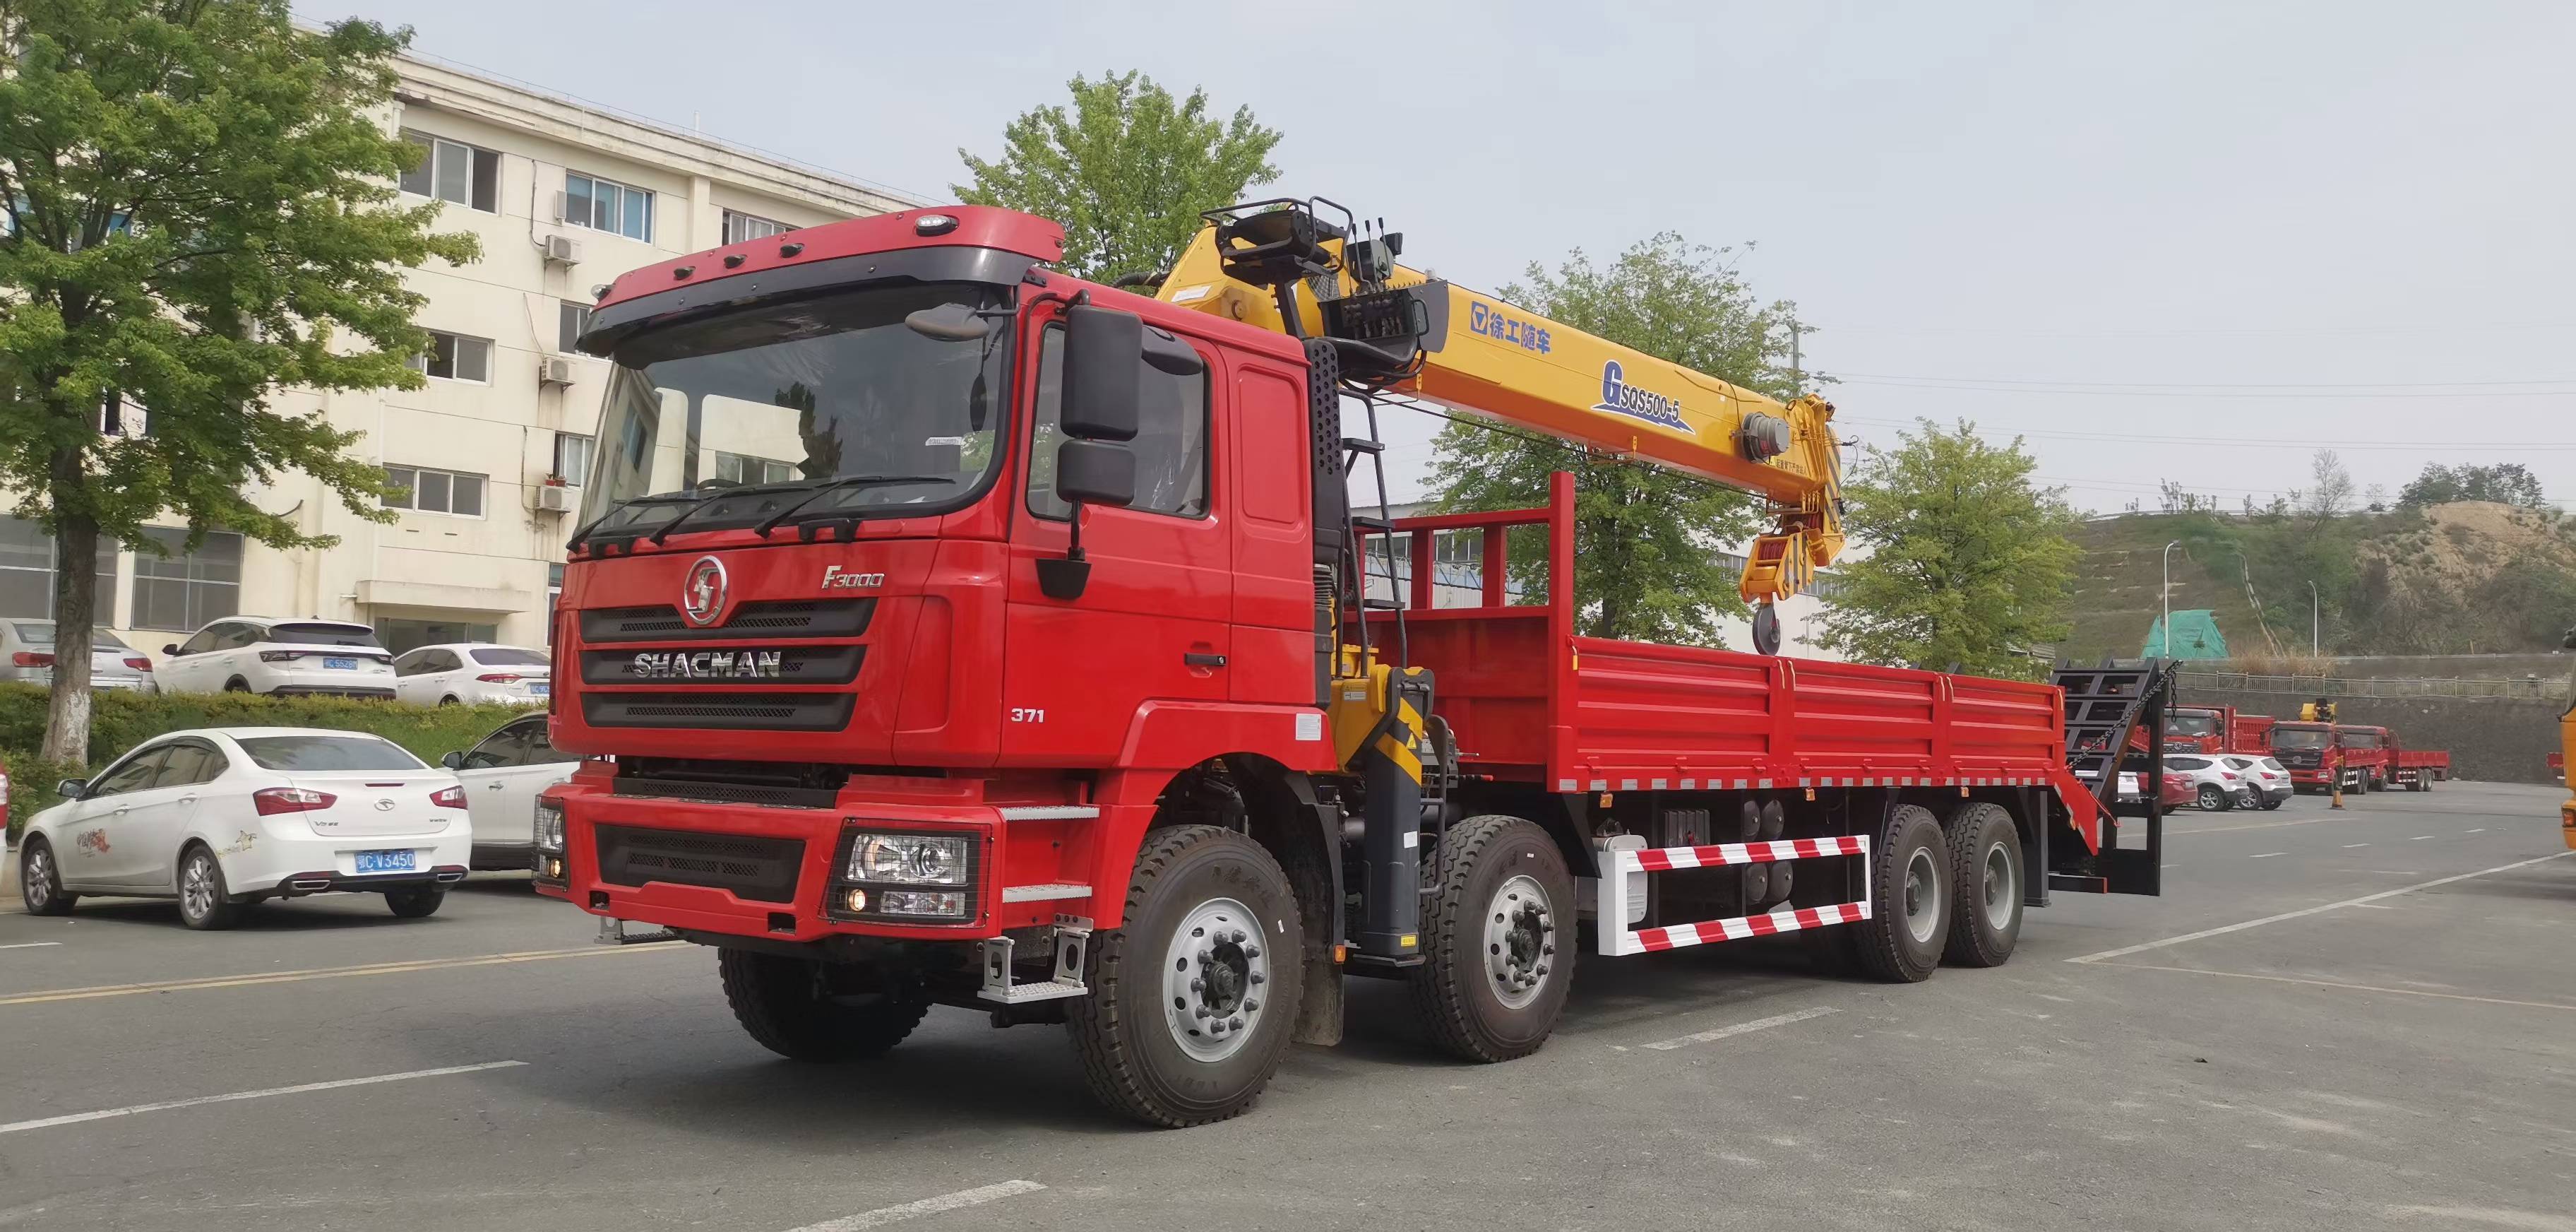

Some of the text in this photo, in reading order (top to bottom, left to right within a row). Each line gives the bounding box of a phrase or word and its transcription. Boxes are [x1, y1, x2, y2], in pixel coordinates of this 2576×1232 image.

[1490, 312, 1551, 354] 徐工随车
[822, 565, 885, 588] F3000
[635, 652, 781, 678] SHACMAN
[1011, 708, 1044, 723] 371
